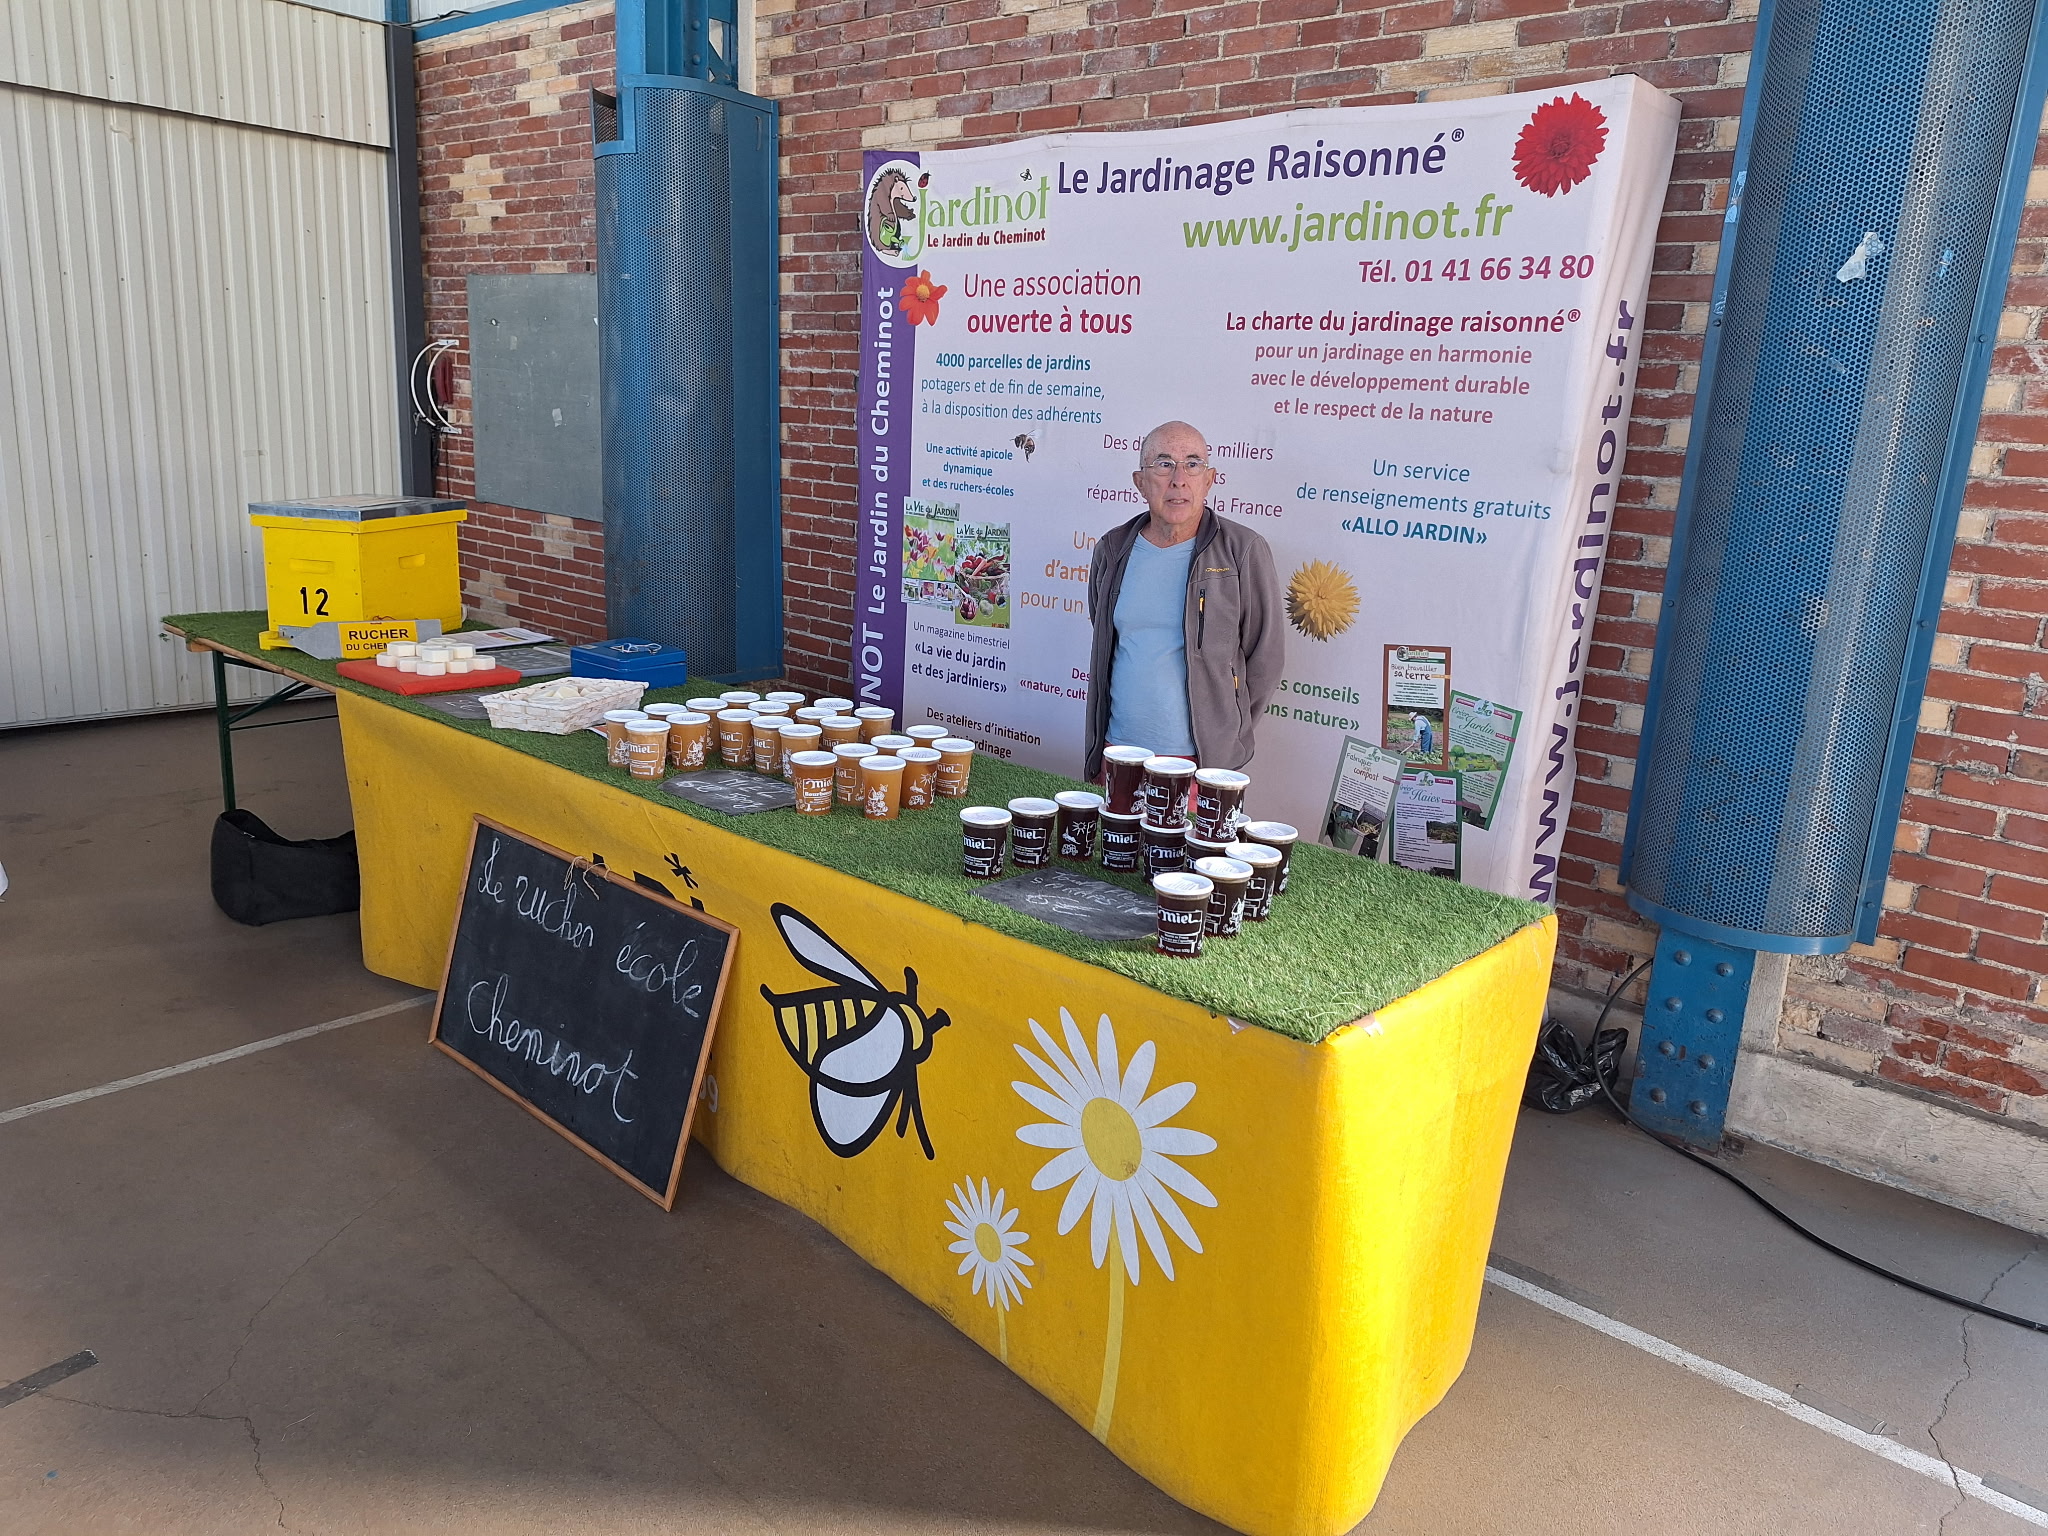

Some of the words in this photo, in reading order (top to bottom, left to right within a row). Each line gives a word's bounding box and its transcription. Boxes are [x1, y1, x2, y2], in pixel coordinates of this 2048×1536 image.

[1057, 161, 1089, 194] Le
[1097, 157, 1255, 196] Jardinage
[1183, 193, 1513, 252] www.jardinot.fr
[927, 233, 940, 248] Le
[942, 232, 973, 247] Jardin
[976, 231, 991, 246] du
[993, 227, 1047, 246] Cheminot
[1358, 259, 1397, 284] Tél.
[1404, 259, 1433, 283] 01
[1441, 258, 1472, 282] 41
[1480, 257, 1512, 281] 66
[1518, 256, 1552, 280] 34
[1559, 254, 1595, 280] 80
[963, 273, 1006, 298] Une
[1012, 268, 1142, 297] association
[967, 312, 1052, 334] ouverte
[1058, 305, 1073, 334] à
[1080, 311, 1133, 335] tous
[1226, 311, 1246, 331] La
[1251, 312, 1313, 332] charte
[1318, 310, 1346, 332] du
[1349, 310, 1454, 337] jardinage
[871, 286, 895, 437] Cheminot
[935, 352, 965, 368] 4000
[967, 353, 1023, 372] parcelles
[1026, 353, 1043, 370] de
[1044, 354, 1092, 374] jardins
[1254, 345, 1294, 363] pour
[1298, 345, 1319, 360] un
[1321, 343, 1405, 365] jardinage
[1409, 347, 1432, 362] en
[1438, 342, 1532, 365] harmonie
[921, 377, 971, 395] potagers
[974, 379, 987, 394] et
[989, 378, 1005, 394] de
[1008, 378, 1024, 395] fin
[1027, 379, 1043, 396] de
[1046, 381, 1106, 401] semaine,
[1250, 371, 1287, 387] avec
[1291, 370, 1306, 387] le
[1309, 371, 1450, 396] développement
[1454, 375, 1530, 396] durable
[921, 399, 928, 413] à
[931, 399, 941, 414] la
[944, 400, 1008, 419] disposition
[1011, 404, 1033, 420] des
[1036, 405, 1102, 424] adhérents
[1273, 400, 1290, 414] et
[1293, 399, 1310, 416] le
[1313, 402, 1376, 422] respect
[1380, 401, 1404, 420] de
[1407, 402, 1425, 421] la
[1429, 407, 1493, 425] nature
[926, 442, 943, 454] Une
[945, 445, 978, 457] activité
[979, 448, 1013, 461] apicole
[1103, 433, 1128, 451] Des
[1217, 441, 1274, 461] milliers
[870, 442, 890, 483] du
[943, 461, 993, 477] dynamique
[1372, 458, 1398, 478] Un
[1402, 462, 1471, 482] service
[922, 478, 931, 487] et
[933, 478, 948, 489] des
[950, 480, 1015, 497] ruchers-écoles
[1086, 483, 1139, 503] répartis
[1213, 495, 1225, 512] la
[1230, 497, 1283, 518] France
[1296, 482, 1318, 500] de
[1322, 485, 1468, 514] renseignements
[1473, 498, 1552, 521] gratuits
[869, 492, 889, 578] Jardin
[1341, 515, 1399, 538] «ALLO
[1402, 518, 1488, 546] JARDIN»
[1045, 559, 1089, 583] d'arti
[299, 586, 330, 617] 12
[868, 582, 886, 615] Le
[1020, 591, 1059, 609] pour
[1063, 598, 1084, 614] un
[346, 643, 361, 651] DU
[363, 642, 388, 651] CHEM
[348, 628, 409, 641] RUCHER
[913, 621, 925, 632] Un
[926, 624, 965, 640] magazine
[967, 631, 1010, 650] bimestriel
[914, 641, 934, 656] «La
[936, 645, 953, 660] vie
[955, 648, 970, 664] du
[971, 651, 1007, 672] jardin
[911, 662, 923, 675] et
[925, 664, 944, 680] des
[945, 668, 1008, 694] jardiniers»
[1405, 670, 1431, 681] terre
[1019, 679, 1064, 698] «nature,
[1066, 687, 1088, 701] cult
[1292, 680, 1360, 705] conseils
[926, 706, 944, 721] Des
[946, 713, 982, 731] ateliers
[984, 721, 1041, 746] d'initiation
[1293, 707, 1360, 731] nature»
[966, 735, 1012, 759] rdinage
[467, 972, 640, 1124] Cheminot
